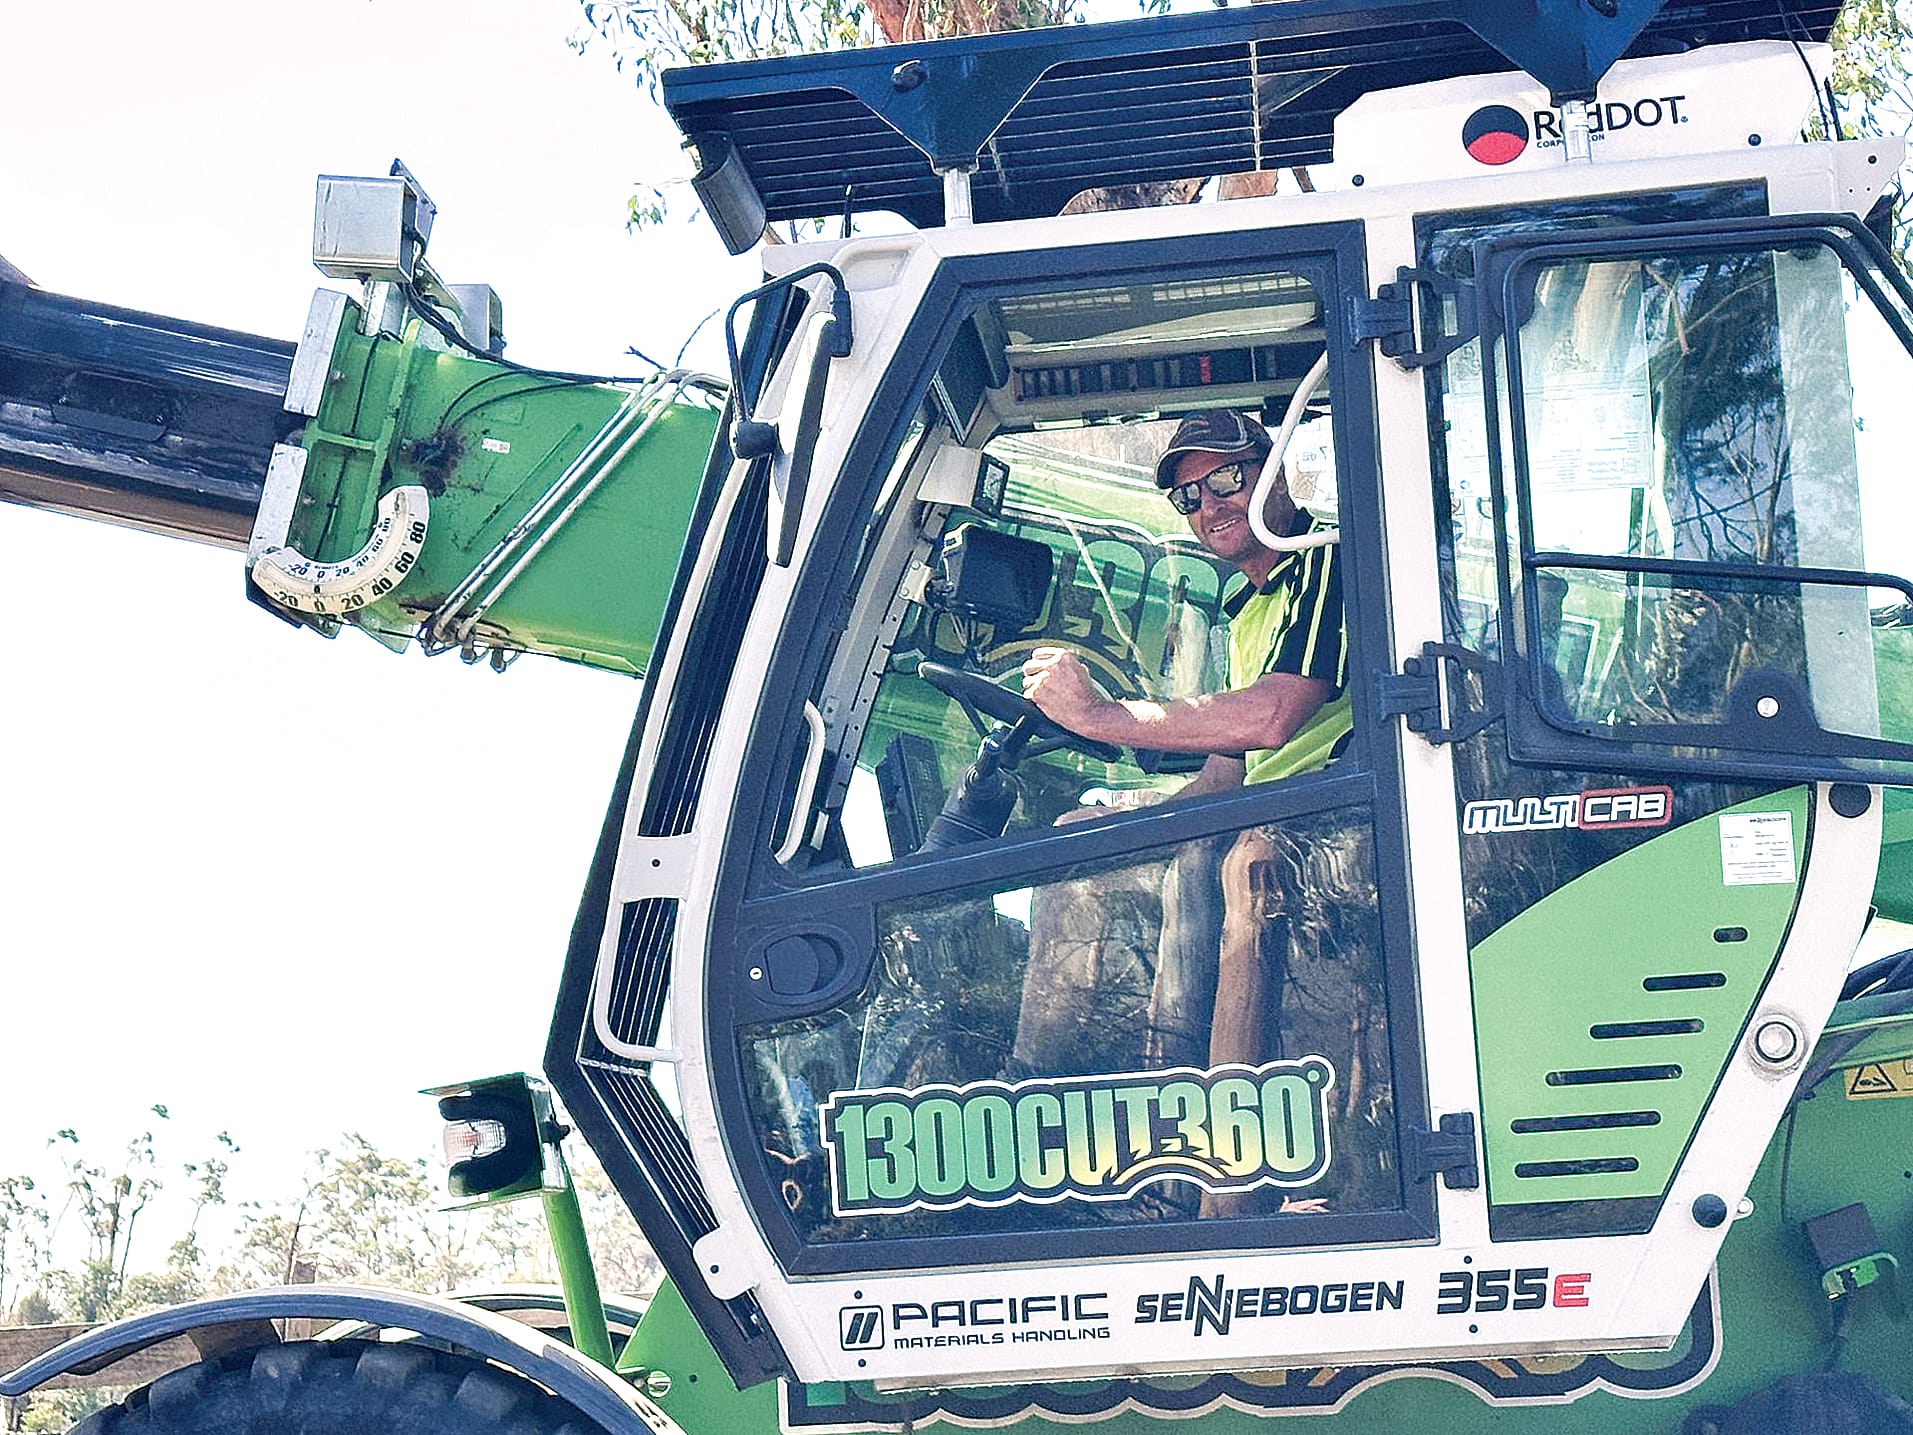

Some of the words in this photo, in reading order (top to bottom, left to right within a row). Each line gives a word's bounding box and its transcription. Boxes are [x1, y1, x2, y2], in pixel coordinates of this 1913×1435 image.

[1533, 95, 1686, 140] RdDOT
[313, 601, 327, 612] 0
[341, 594, 365, 610] 20
[371, 577, 393, 597] 40
[394, 551, 415, 574] 60
[409, 520, 427, 545] 80
[335, 566, 350, 577] 20
[891, 1292, 1110, 1331] PACIFIC
[1133, 1273, 1405, 1337] SENNEBOGEN
[1436, 1266, 1593, 1315] 355E
[893, 1331, 1005, 1350] MATERIALS
[1011, 1326, 1111, 1344] HANDLING
